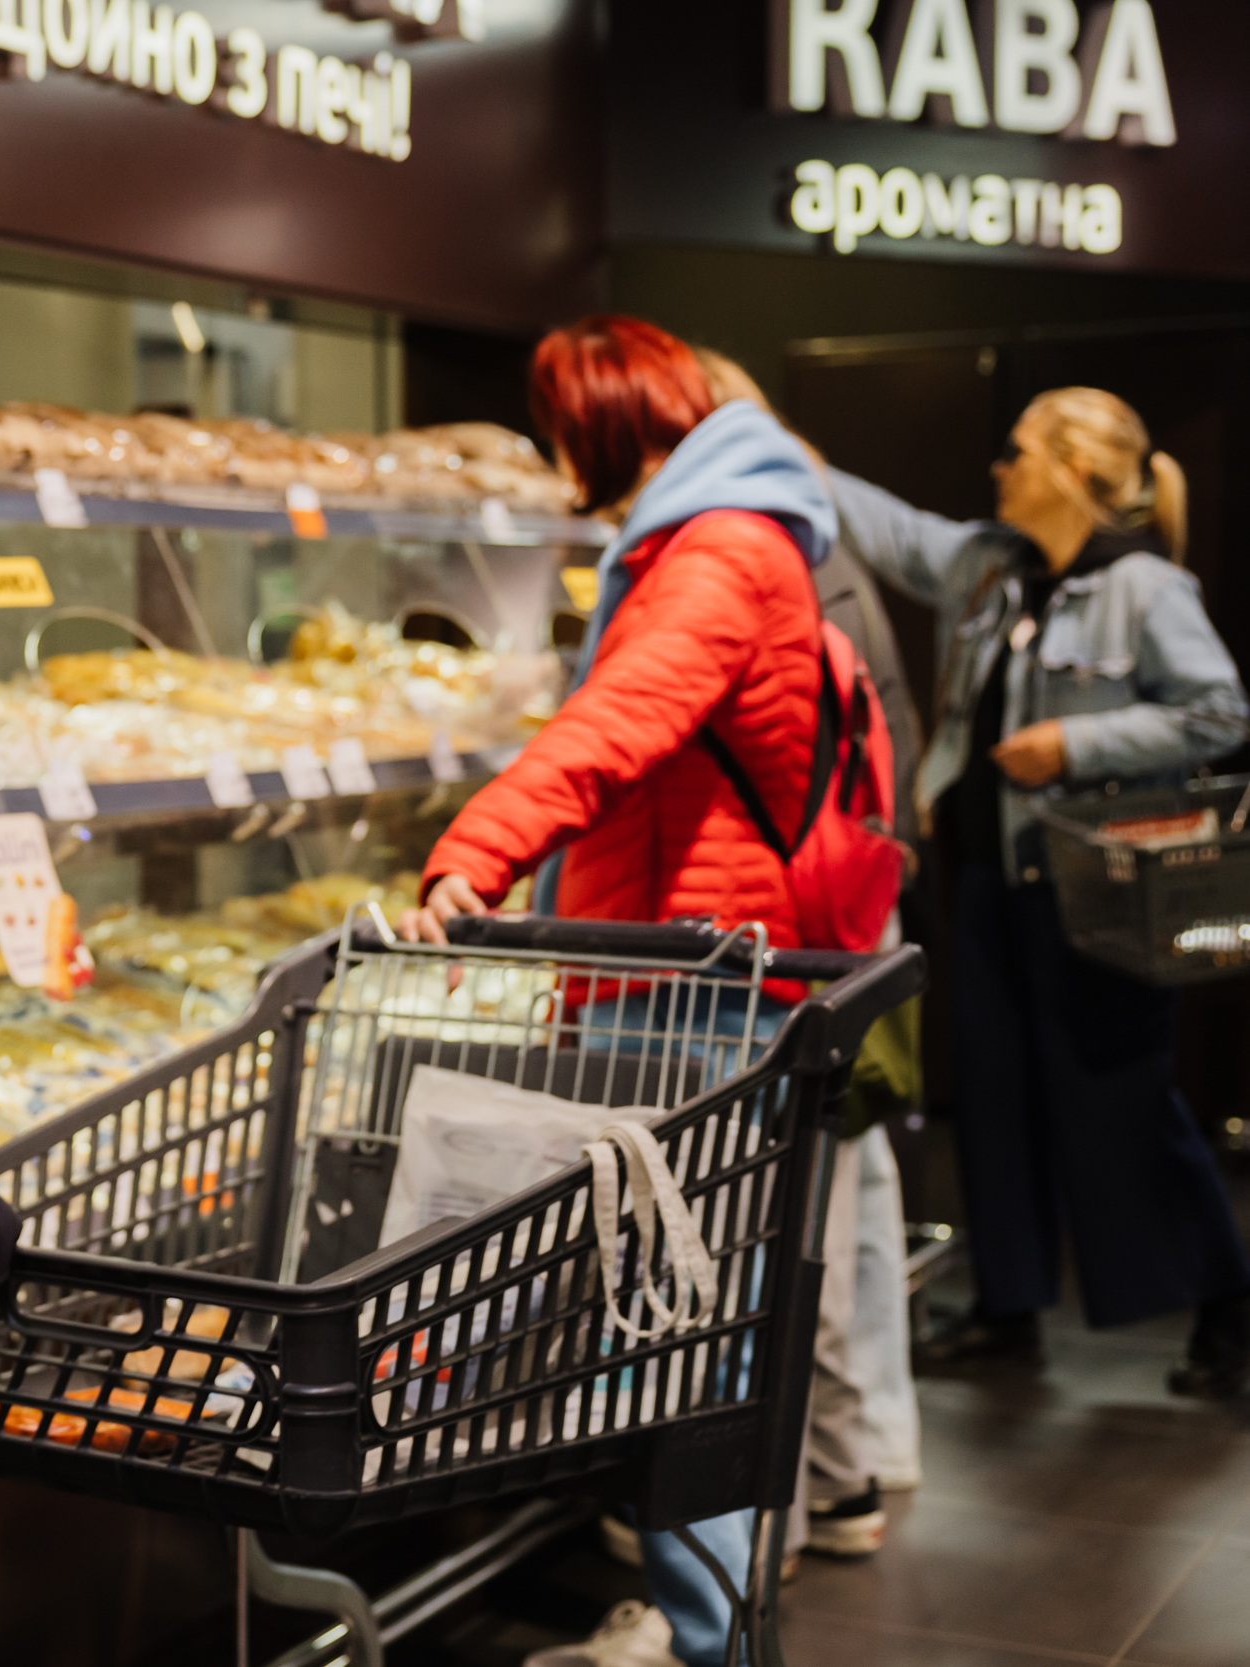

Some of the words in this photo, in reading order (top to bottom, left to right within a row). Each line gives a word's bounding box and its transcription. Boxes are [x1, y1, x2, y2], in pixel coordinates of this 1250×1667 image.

[227, 27, 268, 118] з
[277, 44, 412, 163] печі!
[788, 0, 1178, 147] КАВА
[791, 159, 1123, 255] ароматна
